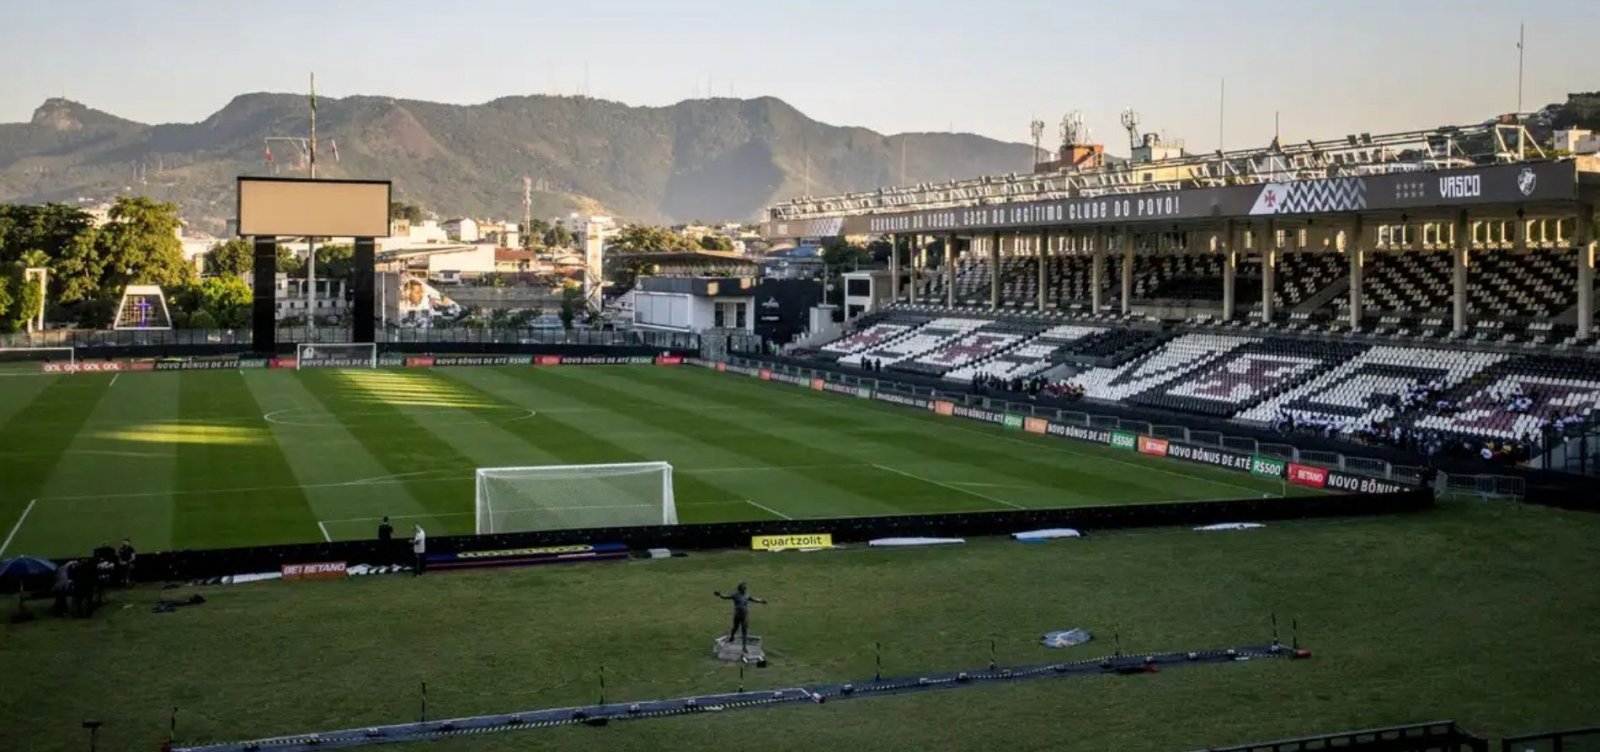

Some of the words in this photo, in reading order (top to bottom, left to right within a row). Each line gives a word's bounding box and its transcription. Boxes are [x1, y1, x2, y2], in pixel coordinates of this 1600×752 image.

[1440, 175, 1480, 198] VASCO
[1114, 200, 1130, 217] DO
[1138, 196, 1180, 215] POVO!
[156, 362, 180, 370] NOVO
[182, 360, 208, 369] BÔNUS
[1048, 424, 1065, 436] NOVO
[1066, 425, 1088, 440] BÔNUS
[1088, 429, 1097, 440] DE
[1098, 429, 1111, 444] ATÉ
[1112, 432, 1134, 446] R$500
[1169, 444, 1190, 458] NOVO
[1192, 448, 1220, 464] BÔNUS
[1222, 454, 1234, 466] DE
[1236, 456, 1250, 470] ATÉ
[1253, 460, 1281, 476] R$500
[1298, 470, 1324, 483] BETANO
[1328, 474, 1358, 490] NOVO
[762, 536, 823, 547] quartzolit
[304, 562, 345, 574] BETANO
